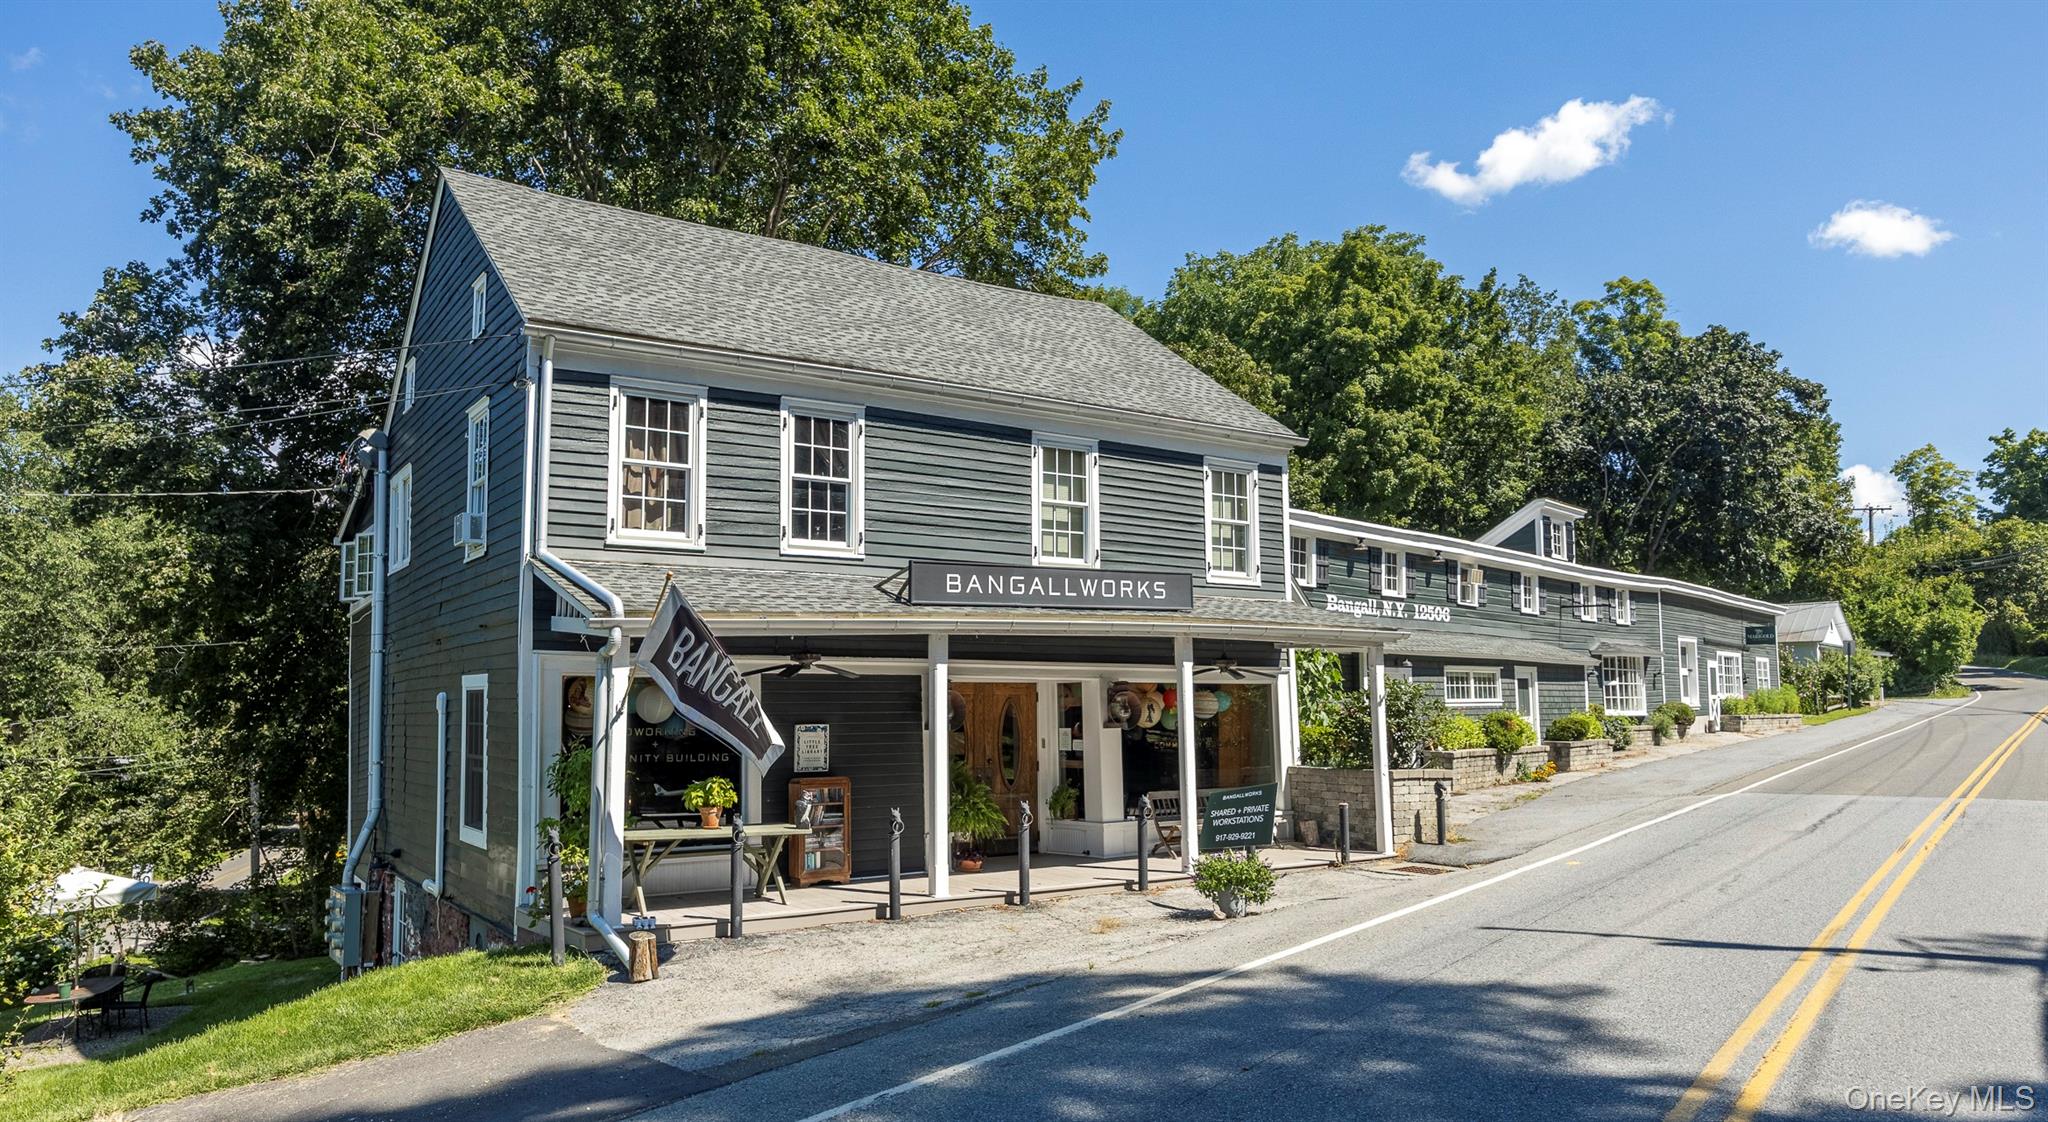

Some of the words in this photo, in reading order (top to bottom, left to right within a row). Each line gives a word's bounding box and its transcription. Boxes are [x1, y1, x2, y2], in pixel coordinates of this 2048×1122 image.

[946, 573, 1166, 599] BANGALLWORKS
[1326, 594, 1380, 618] Bangall,
[1382, 600, 1408, 618] N.Y.
[1413, 604, 1451, 622] 12506
[667, 626, 763, 739] BANGALL
[666, 753, 730, 762] BUILDING
[1222, 790, 1263, 801] BANGALLWORKS
[1210, 807, 1237, 818] SHARED
[1242, 804, 1270, 815] PRIVATE
[1212, 815, 1264, 827] WORKSTATIONS
[1215, 832, 1256, 842] 917-929-9221
